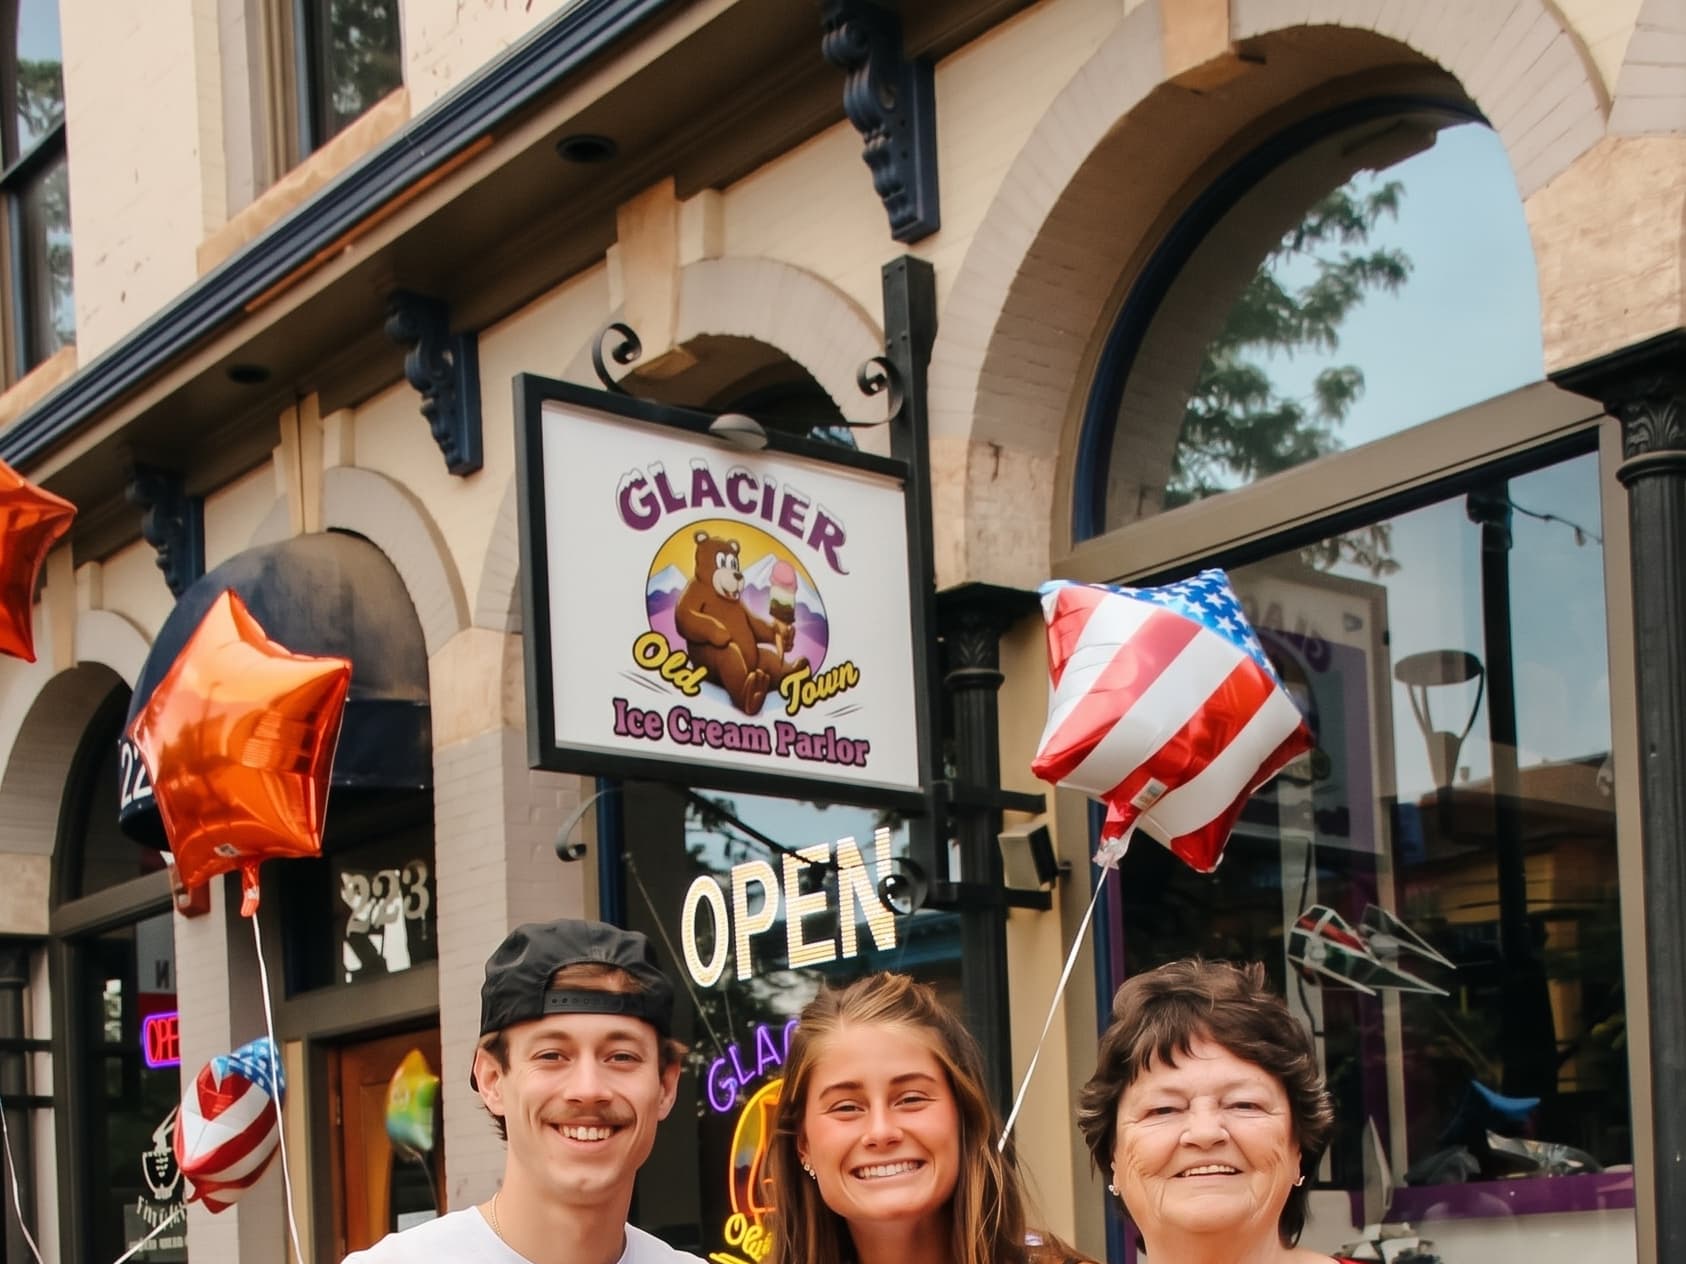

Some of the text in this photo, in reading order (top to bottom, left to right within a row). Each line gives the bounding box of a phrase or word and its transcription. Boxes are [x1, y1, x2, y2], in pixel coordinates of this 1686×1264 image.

[616, 457, 850, 575] GLACIER
[633, 631, 860, 715] Old Town
[612, 698, 870, 767] Ice Cream Parlor
[681, 826, 897, 988] OPEN
